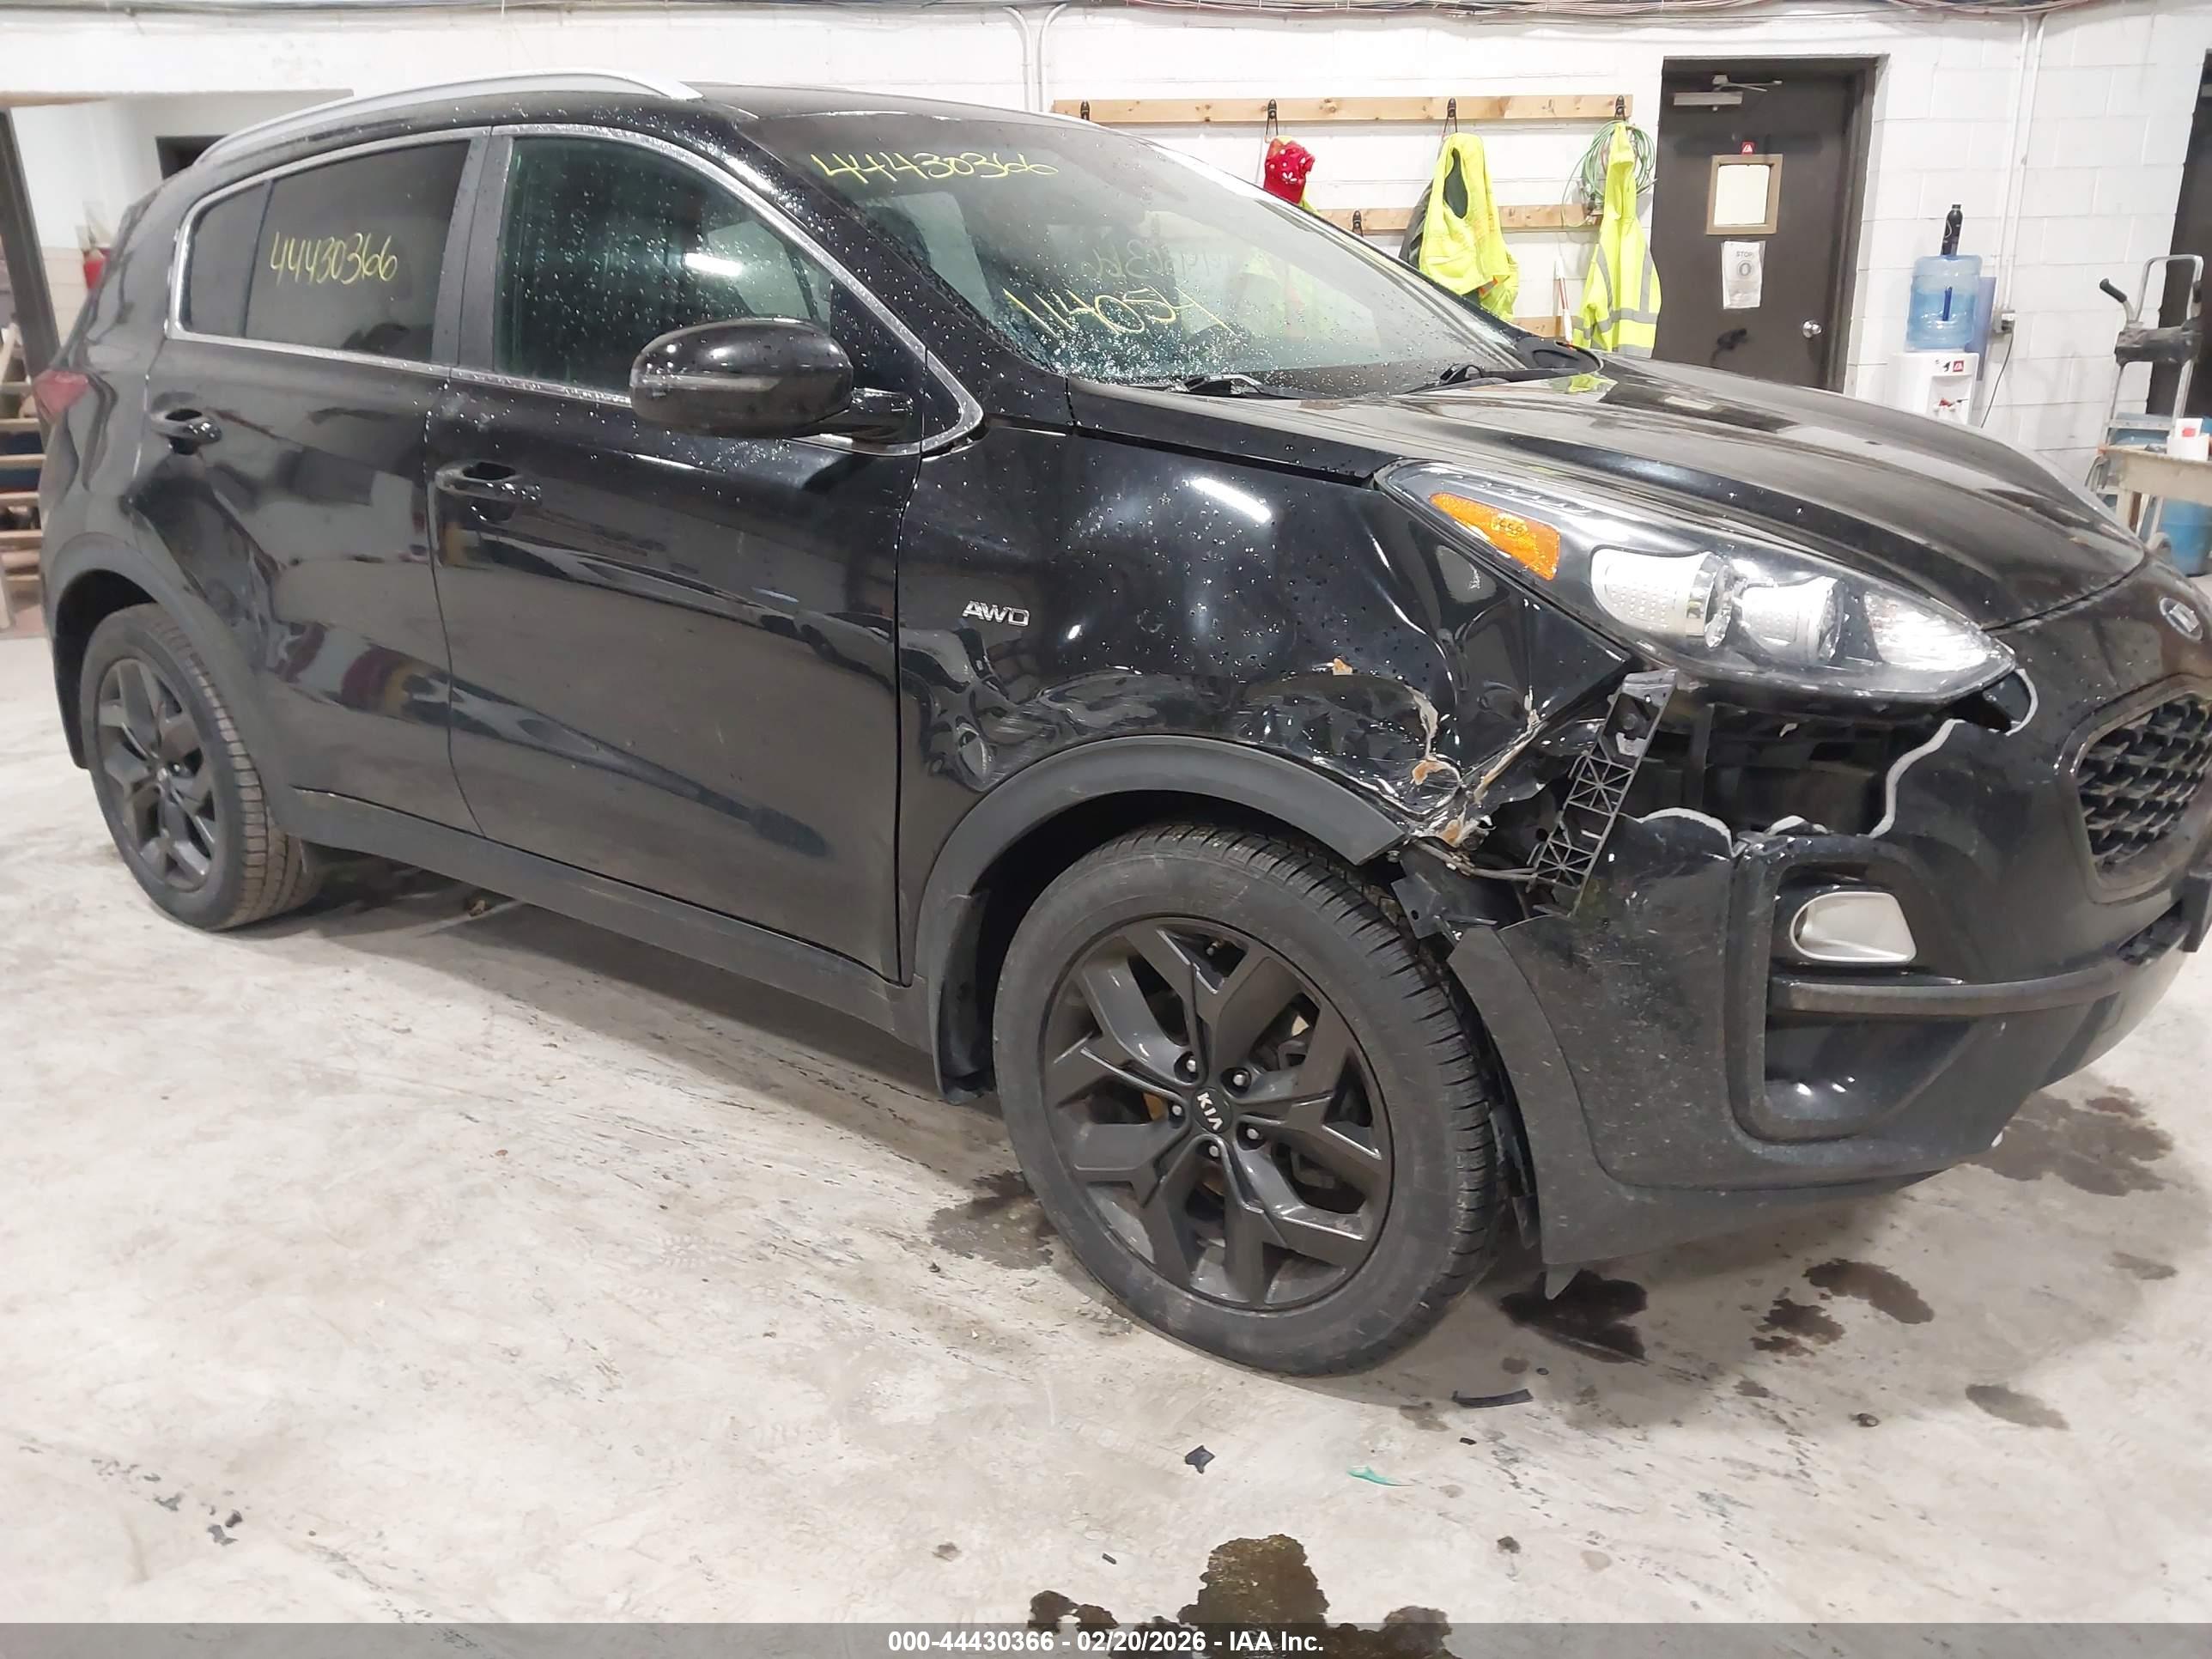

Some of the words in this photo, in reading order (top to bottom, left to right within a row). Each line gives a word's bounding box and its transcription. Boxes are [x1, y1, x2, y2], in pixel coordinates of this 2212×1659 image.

[810, 152, 1060, 184] 44430366
[270, 231, 398, 286] 44430366
[962, 600, 1030, 627] AWD
[1196, 1091, 1224, 1131] KIA
